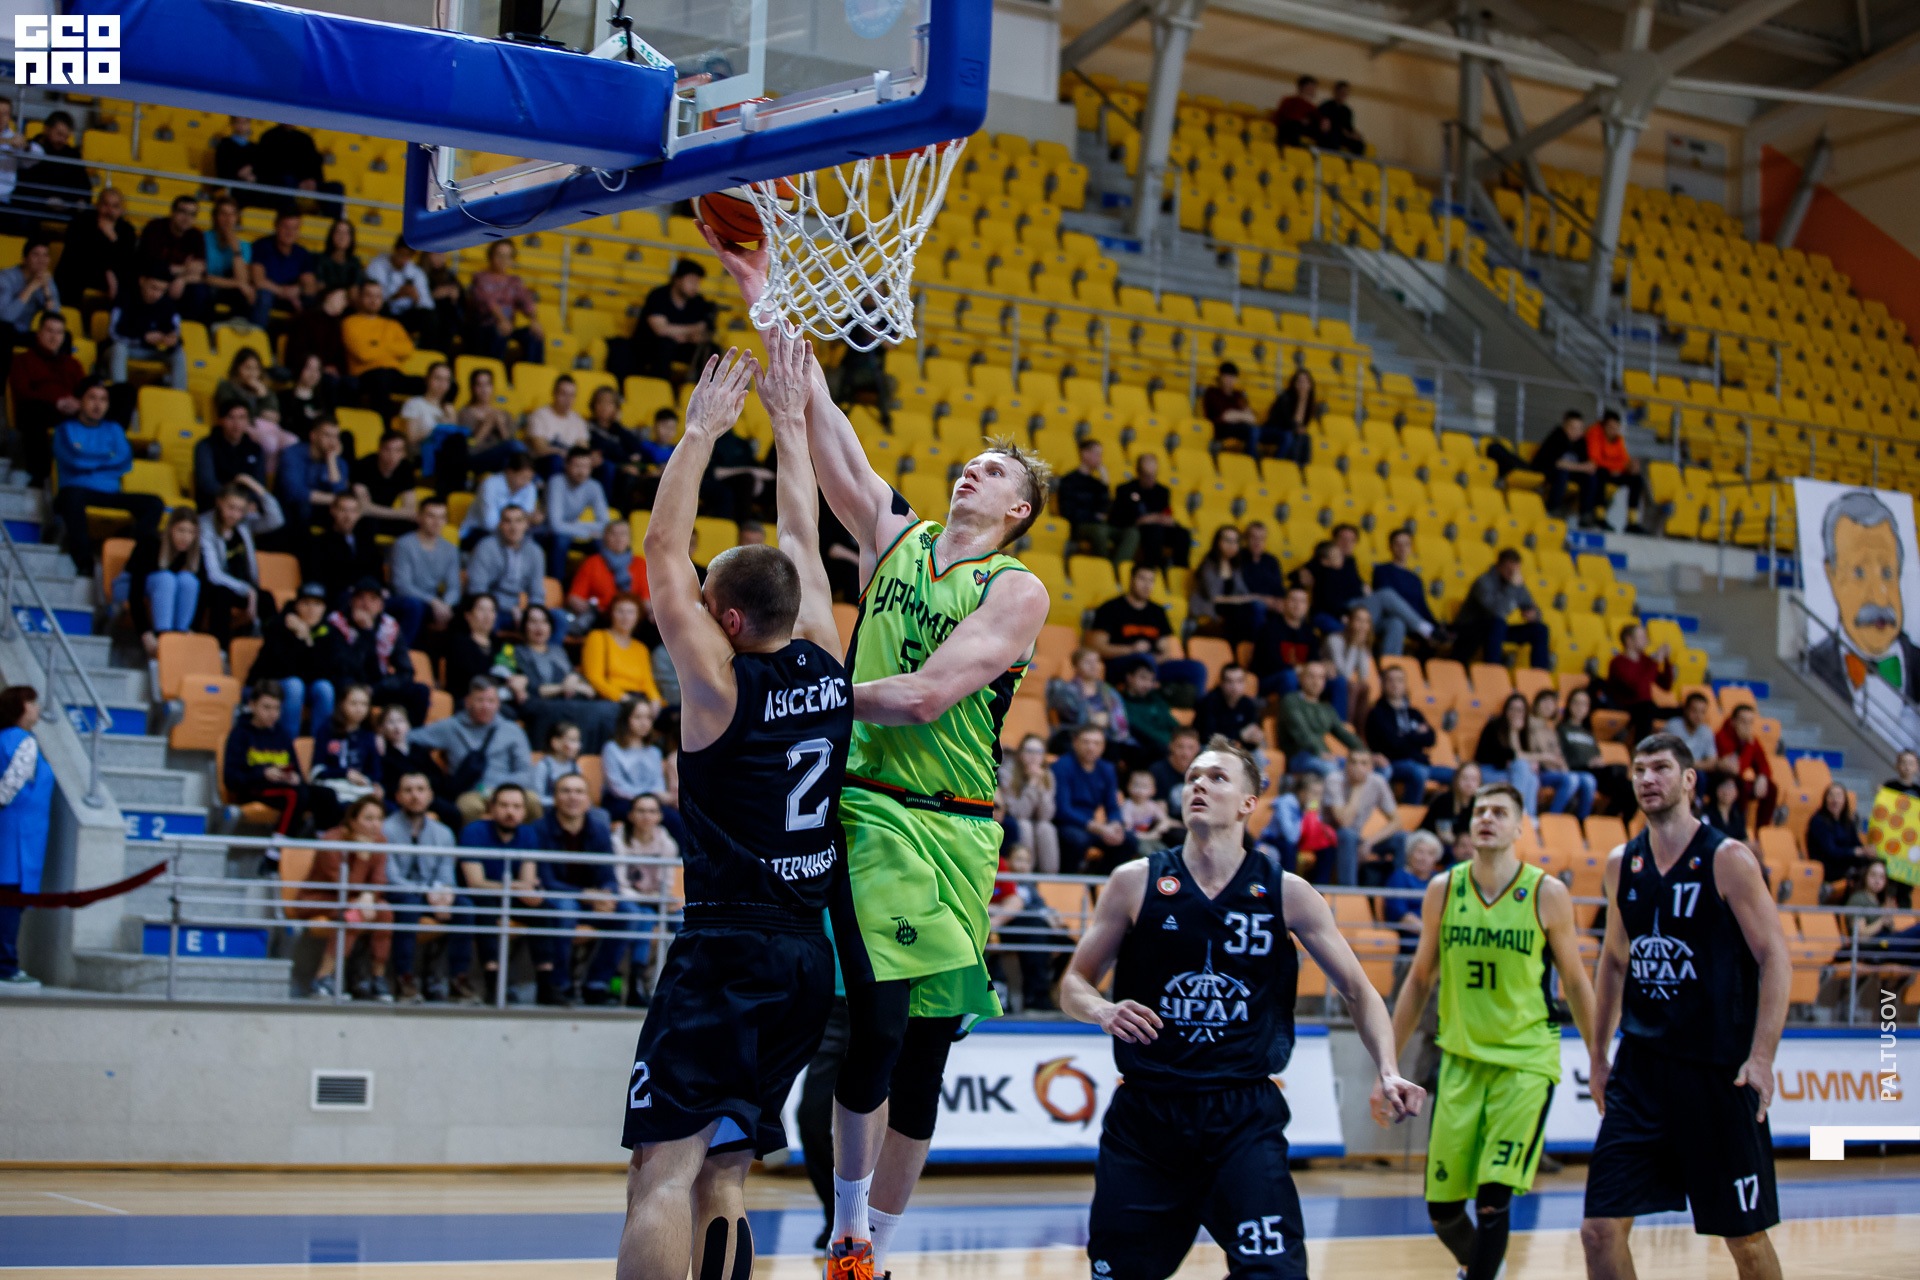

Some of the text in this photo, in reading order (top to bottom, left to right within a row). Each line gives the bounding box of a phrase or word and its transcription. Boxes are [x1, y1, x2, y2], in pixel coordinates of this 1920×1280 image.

[786, 737, 833, 832] 2
[125, 815, 166, 838] E 2
[1672, 882, 1702, 918] 17
[186, 930, 227, 952] E 1
[1223, 911, 1275, 956] 35
[1466, 961, 1497, 990] 31
[1631, 959, 1698, 980] УРАЛ
[1159, 995, 1249, 1022] УРАЛ
[630, 1061, 652, 1109] 2
[1777, 1069, 1903, 1101] UMMC
[1492, 1140, 1524, 1168] 31
[1733, 1173, 1760, 1212] 17
[1237, 1214, 1286, 1256] 35
